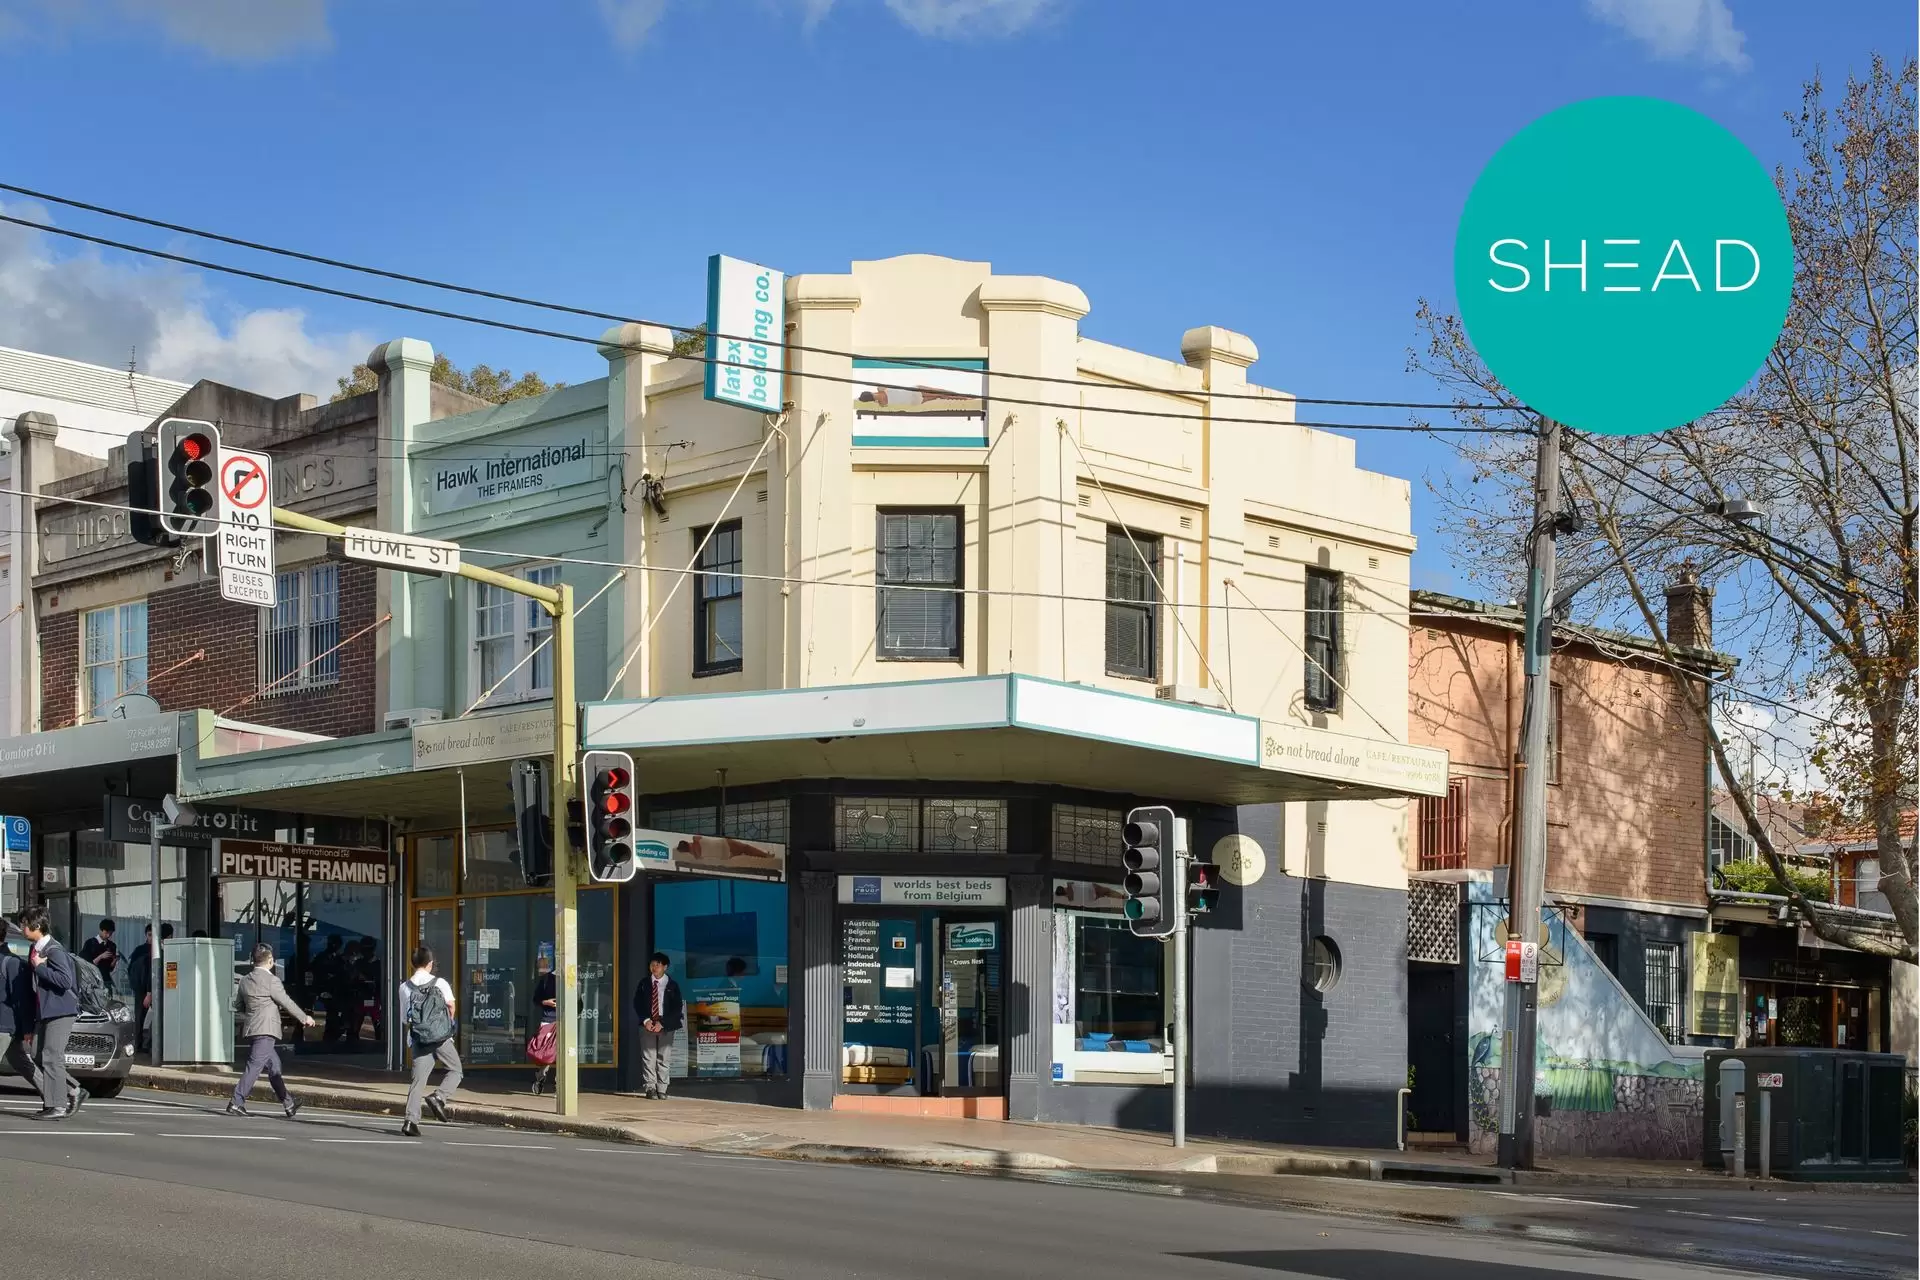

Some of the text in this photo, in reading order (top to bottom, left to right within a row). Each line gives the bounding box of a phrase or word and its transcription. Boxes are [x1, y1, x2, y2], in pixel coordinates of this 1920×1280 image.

[755, 271, 770, 303] co.
[722, 340, 742, 396] latex
[437, 438, 585, 491] Hawk International
[477, 473, 543, 498] THE FRAMERS
[231, 511, 260, 531] NO
[226, 533, 266, 550] RIGHT
[352, 533, 453, 565] HUME ST
[228, 551, 266, 568] TURN
[232, 573, 263, 587] BUSES
[228, 584, 268, 600] EXCEPTED
[432, 739, 446, 751] not
[448, 732, 470, 749] bread
[472, 731, 496, 746] alone
[0, 740, 56, 762] Comfort Fit
[1286, 743, 1360, 767] not bread alone
[229, 813, 259, 832] Fit
[262, 843, 341, 857] Hawk International
[222, 852, 386, 884] PICTURE FRAMING
[893, 880, 992, 890] worlds best beds
[903, 890, 982, 903] from Belgium
[473, 990, 491, 1004] For
[472, 1006, 502, 1019] Lease
[577, 1008, 599, 1019] ase
